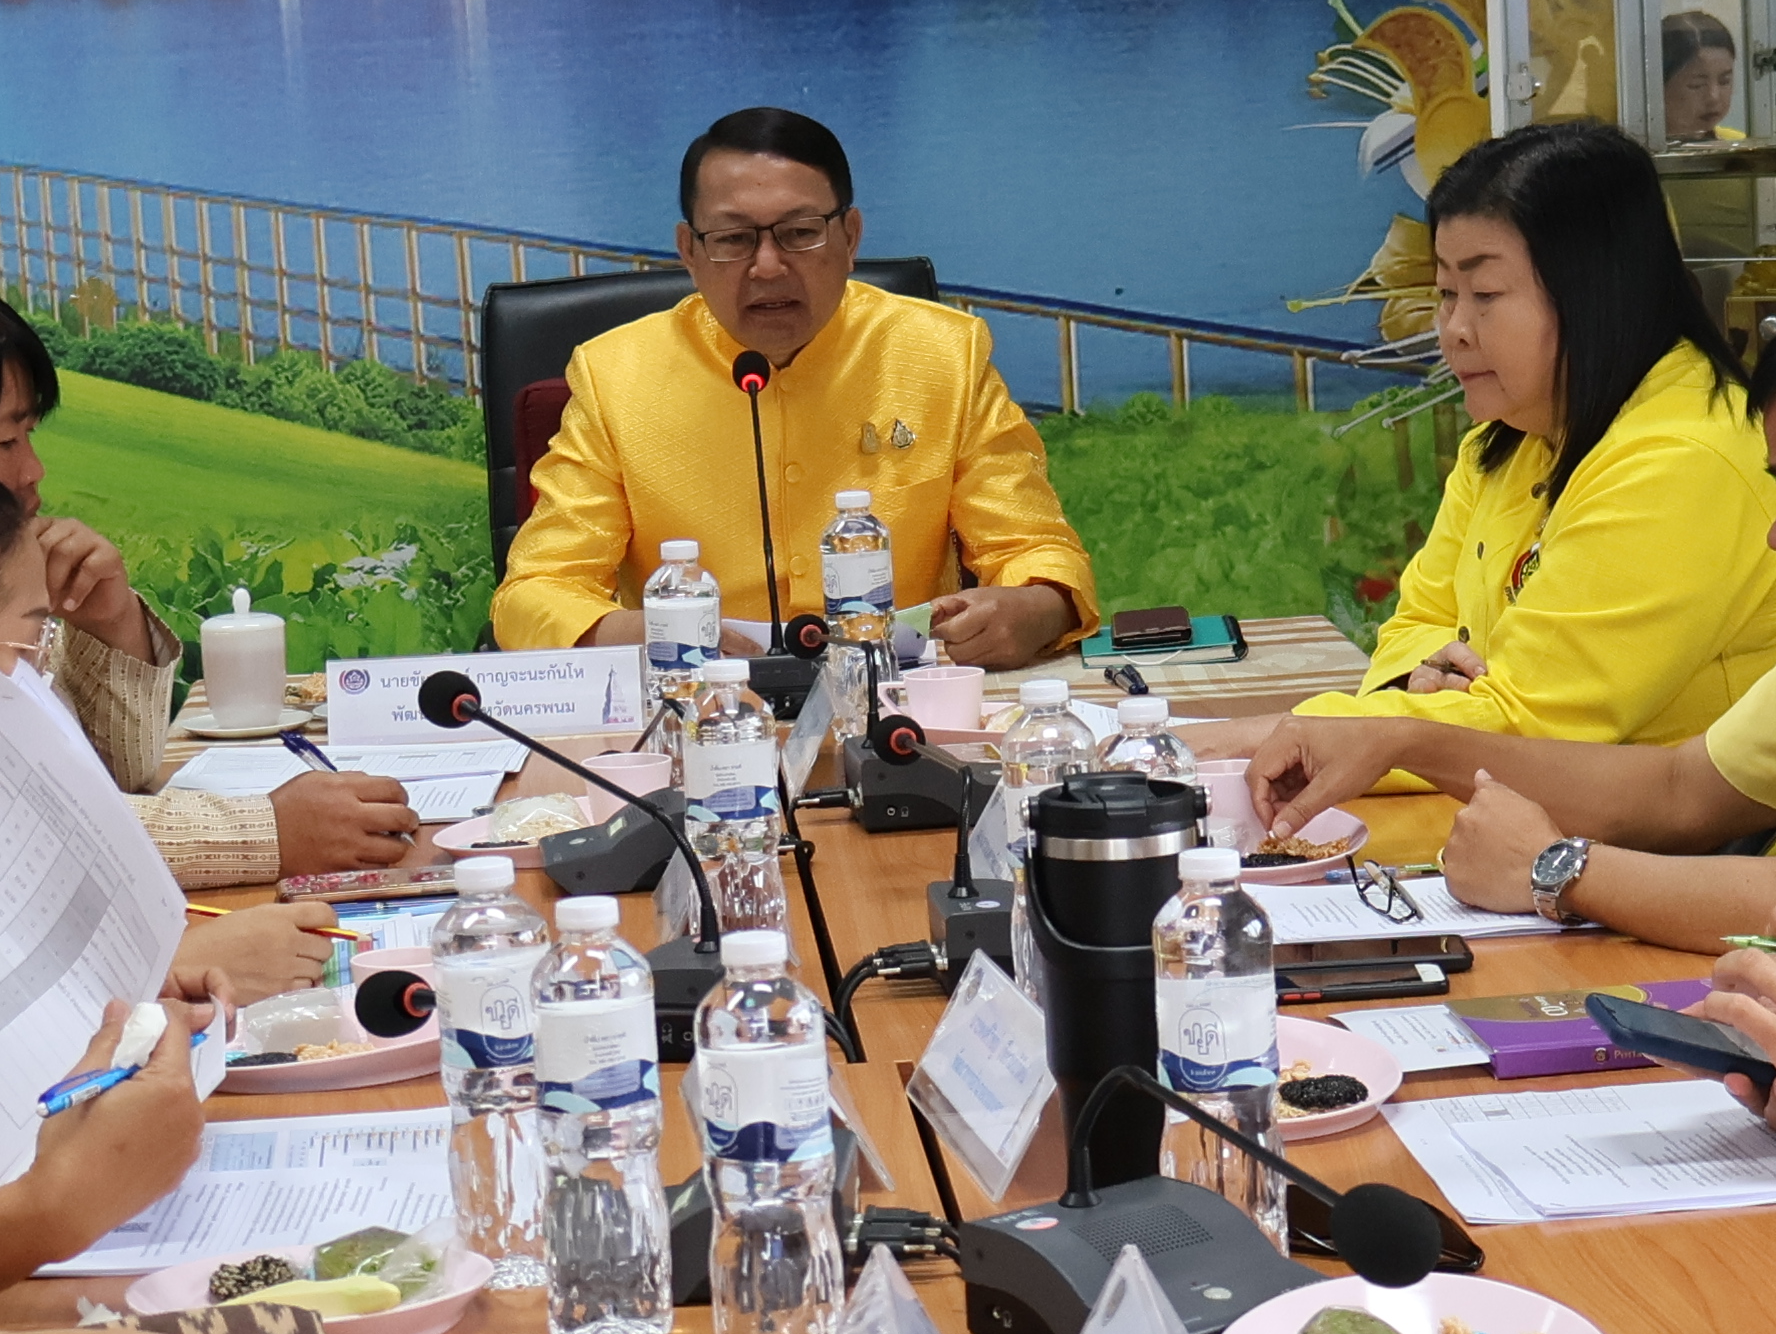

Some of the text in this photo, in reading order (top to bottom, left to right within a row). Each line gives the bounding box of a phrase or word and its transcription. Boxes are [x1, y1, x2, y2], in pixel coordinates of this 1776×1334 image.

[476, 664, 585, 687] กาญจะนะกันโห
